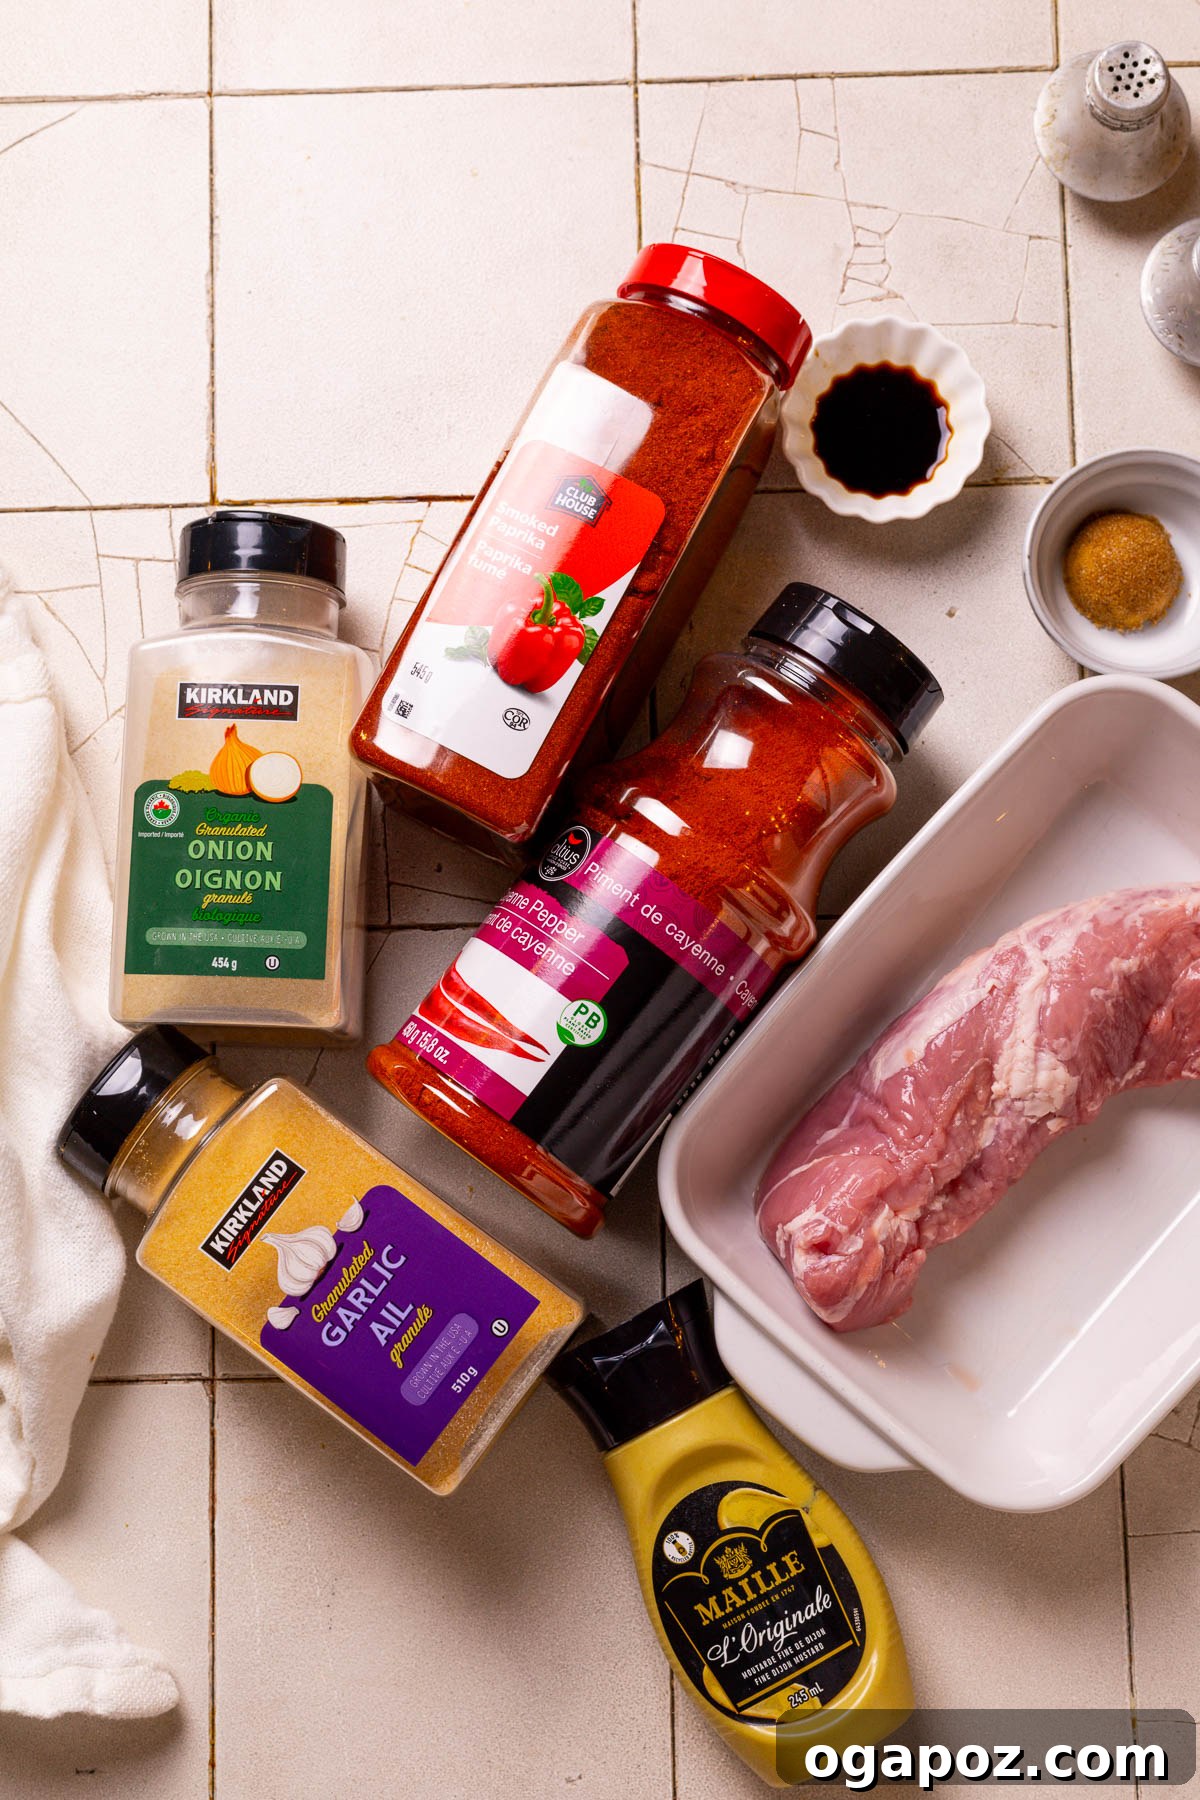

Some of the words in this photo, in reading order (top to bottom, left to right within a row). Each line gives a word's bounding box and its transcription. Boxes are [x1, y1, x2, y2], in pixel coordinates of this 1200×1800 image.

[555, 493, 597, 519] HOUSE
[566, 486, 596, 507] CLUB
[488, 516, 546, 550] Paprika
[496, 502, 559, 537] Smoked
[468, 554, 506, 580] fumé
[476, 541, 532, 575] Paprika
[411, 662, 428, 679] 545
[186, 687, 294, 706] KIRKLAND
[185, 704, 293, 719] Signature
[505, 710, 528, 729] COR
[206, 808, 260, 824] Organic
[196, 823, 267, 837] Granulated
[188, 839, 273, 862] ONION
[175, 868, 282, 891] OIGNON
[202, 892, 253, 909] granulé
[192, 906, 262, 926] biologique
[528, 899, 585, 944] Pepper
[584, 861, 641, 908] Piment
[640, 900, 663, 925] de
[665, 924, 726, 977] cayenne
[496, 916, 512, 933] de
[511, 927, 576, 976] cayenne
[211, 956, 229, 969] 454
[231, 958, 237, 971] g
[564, 1016, 577, 1028] PLANT
[578, 1027, 592, 1038] BASED
[573, 1002, 601, 1029] PB
[408, 1029, 420, 1044] g
[416, 1031, 439, 1053] 15.8
[210, 1159, 288, 1255] KIRKLAND
[226, 1171, 298, 1263] Signature
[311, 1240, 374, 1323] Granulated
[321, 1244, 407, 1347] GARLIC
[369, 1300, 414, 1347] AIL
[389, 1303, 433, 1368] granulé
[410, 1362, 433, 1388] GROWN
[430, 1352, 439, 1362] IN
[436, 1337, 451, 1353] THE
[447, 1323, 462, 1339] USA
[451, 1372, 471, 1393] 510
[468, 1366, 478, 1377] g
[666, 1533, 679, 1544] 100%
[694, 1550, 806, 1626] MAILLE
[722, 1613, 746, 1630] MAISON
[770, 1594, 780, 1602] EN
[780, 1584, 796, 1597] 1747
[706, 1584, 833, 1668] L'Originale
[741, 1656, 777, 1680] MOUTARDE
[777, 1646, 794, 1659] FINE
[794, 1640, 804, 1650] DE
[804, 1628, 826, 1644] DIJON
[754, 1672, 771, 1686] FINE
[771, 1660, 793, 1677] DIJON
[793, 1642, 824, 1664] MUSTARD
[788, 1690, 808, 1707] 245
[809, 1682, 824, 1696] mL
